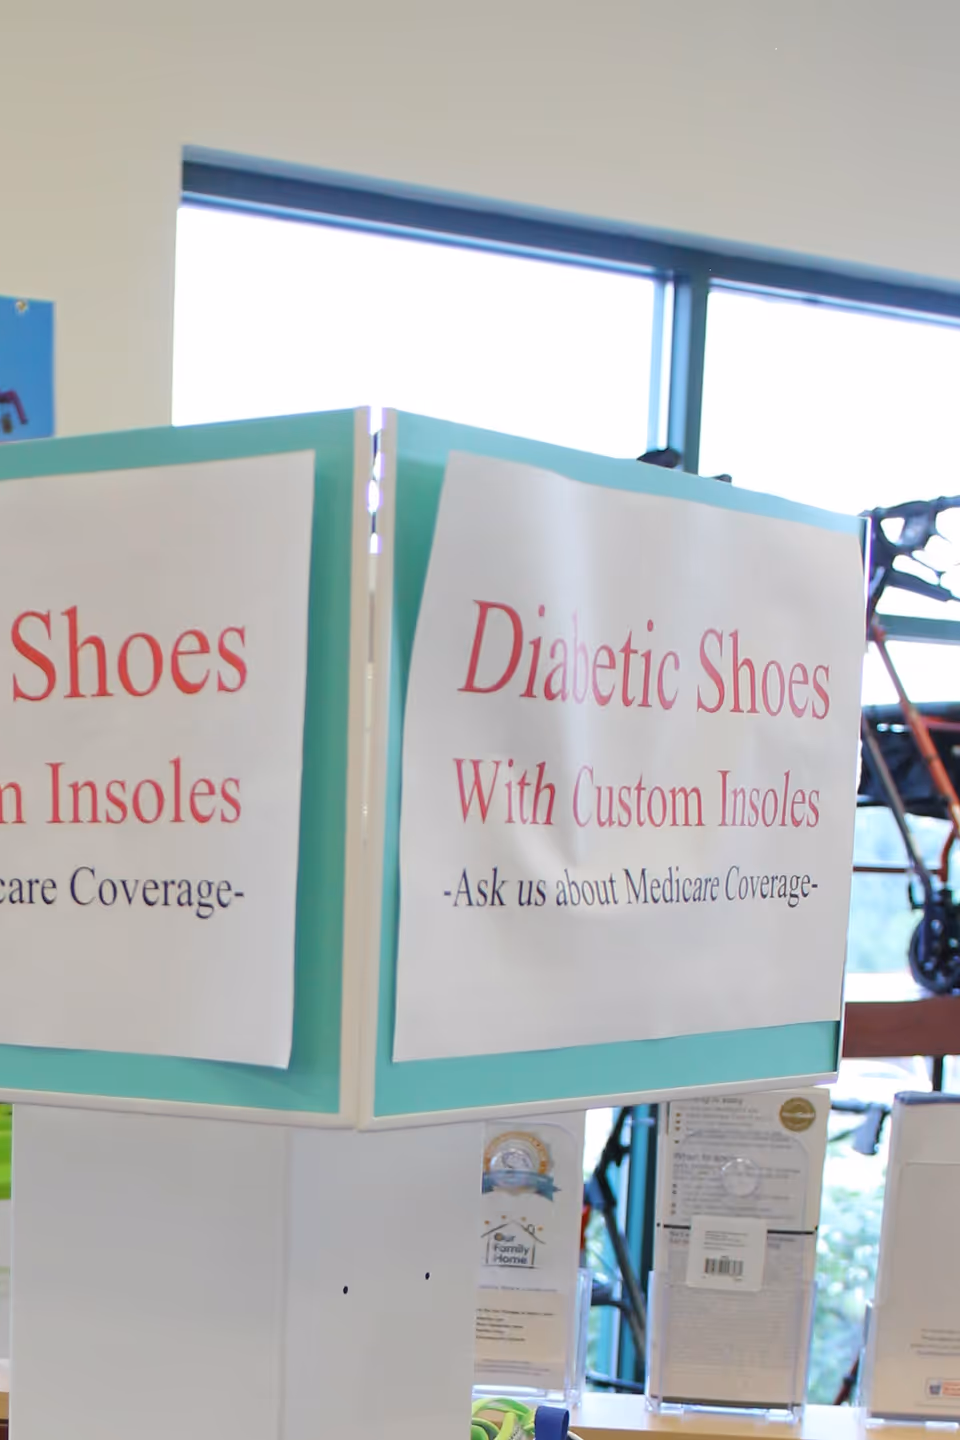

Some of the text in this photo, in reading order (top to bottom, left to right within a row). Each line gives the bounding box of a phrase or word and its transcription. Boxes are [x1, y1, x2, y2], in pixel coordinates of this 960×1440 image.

[11, 606, 247, 701] Shoes
[457, 600, 830, 719] Diabetic Shoes
[45, 757, 242, 825] Insoles
[453, 758, 820, 828] With Custom Insoles
[69, 867, 245, 919] Coverage-
[444, 866, 819, 909] -Ask us about Medicare Coverage-
[494, 1243, 530, 1256] Family
[494, 1254, 528, 1265] Home
